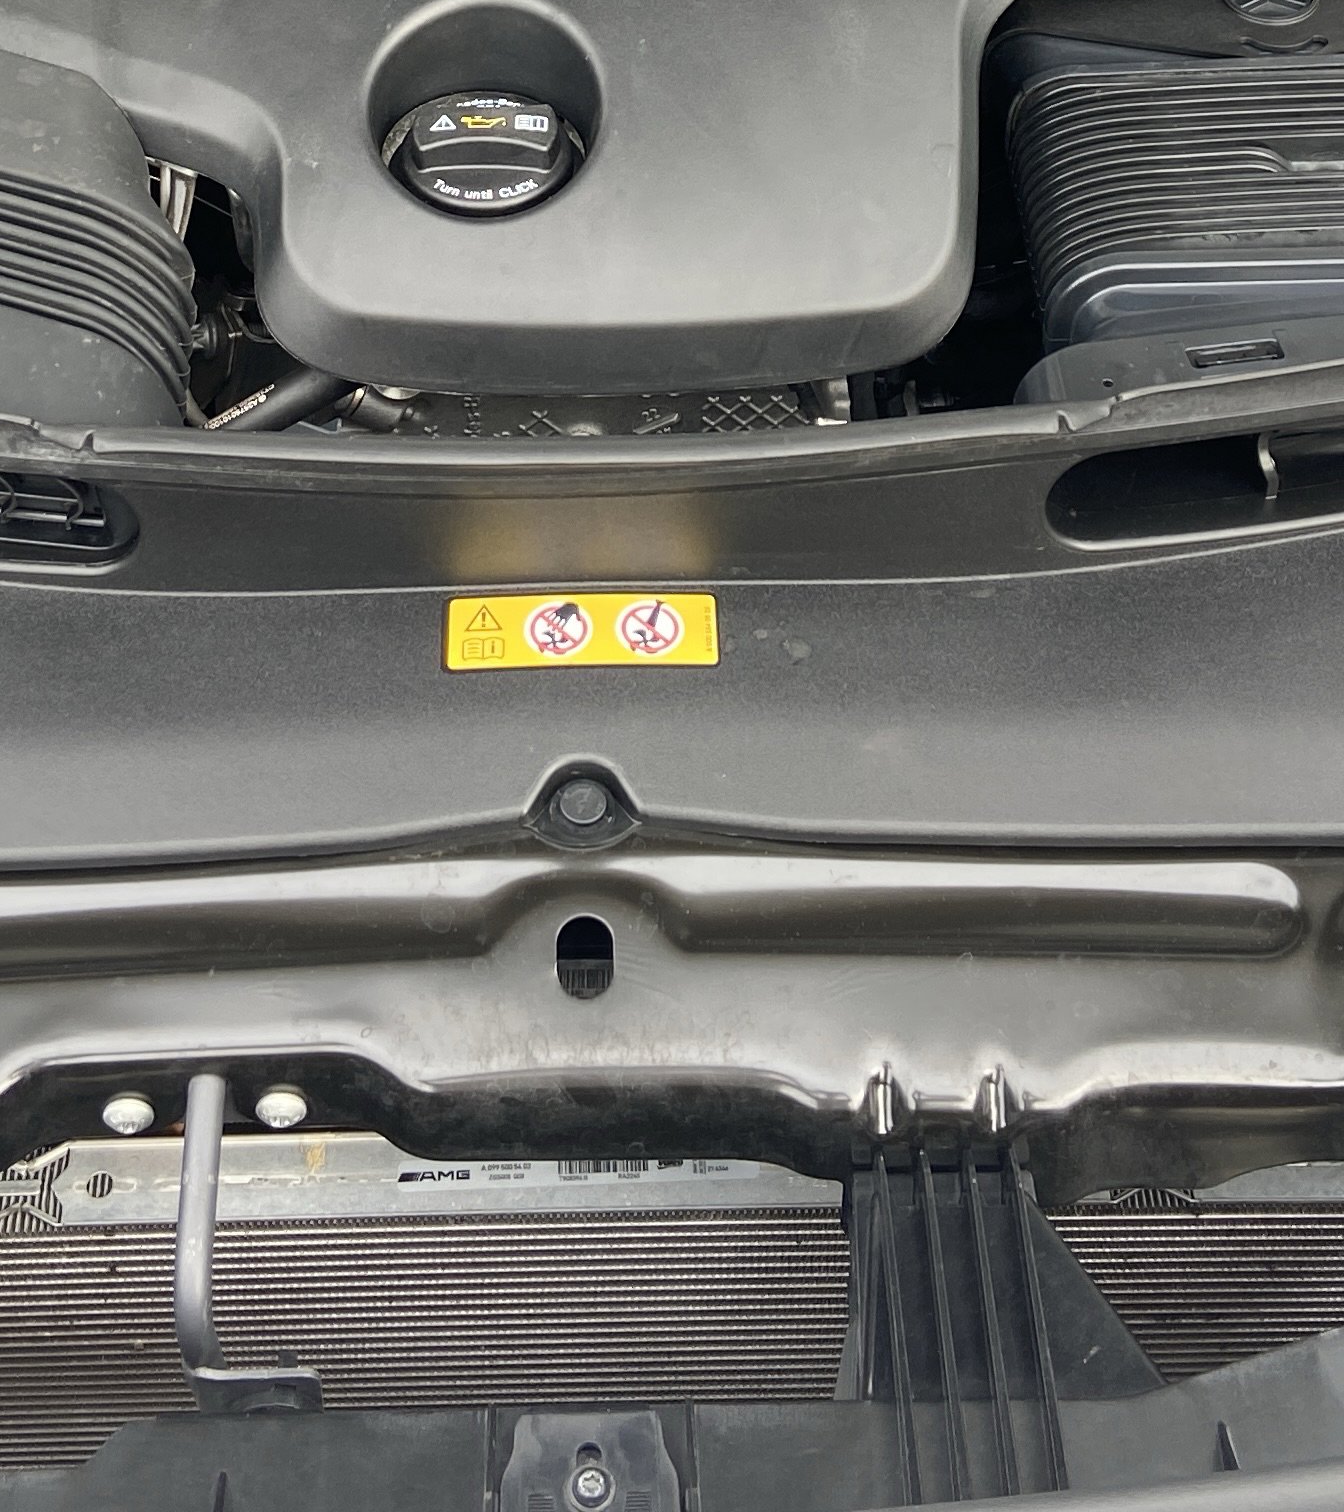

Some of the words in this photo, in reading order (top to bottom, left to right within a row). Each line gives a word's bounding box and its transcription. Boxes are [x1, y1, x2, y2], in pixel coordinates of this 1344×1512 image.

[433, 178, 461, 197] Turn
[464, 190, 494, 200] until
[498, 178, 539, 199] CLICK
[419, 1169, 471, 1182] AMG
